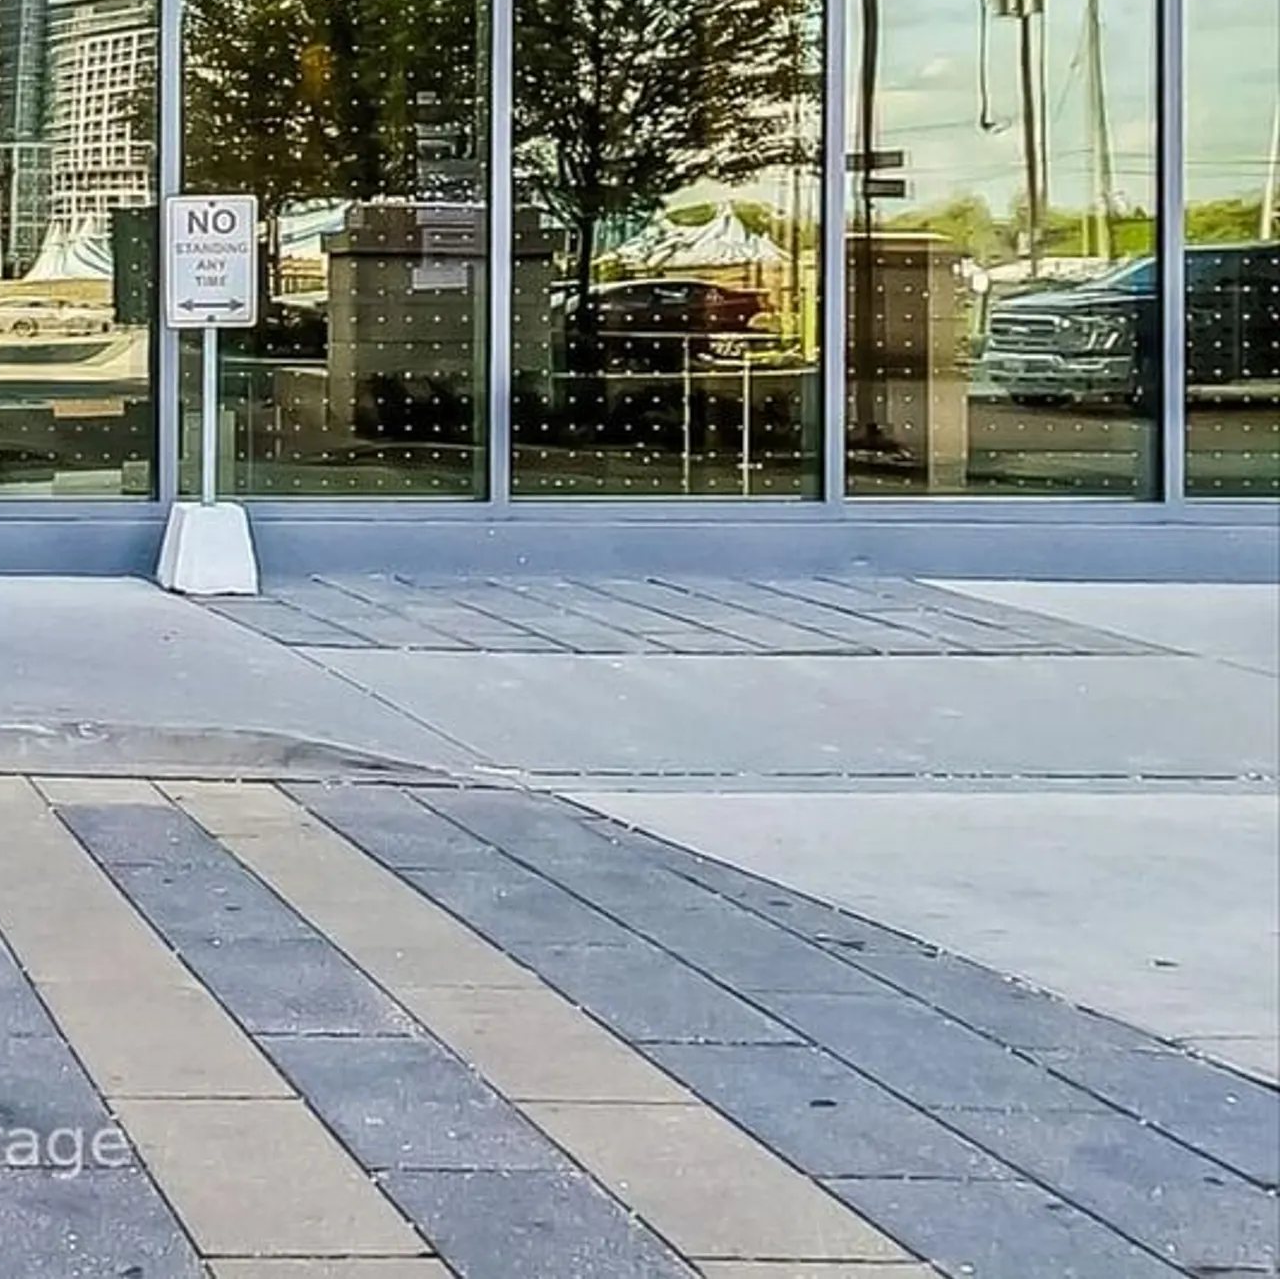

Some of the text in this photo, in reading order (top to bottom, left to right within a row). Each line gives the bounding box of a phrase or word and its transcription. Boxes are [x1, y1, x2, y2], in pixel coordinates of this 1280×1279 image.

[187, 209, 237, 234] NO
[175, 241, 248, 254] STANDING
[195, 260, 226, 271] ANY
[195, 276, 228, 287] TIME
